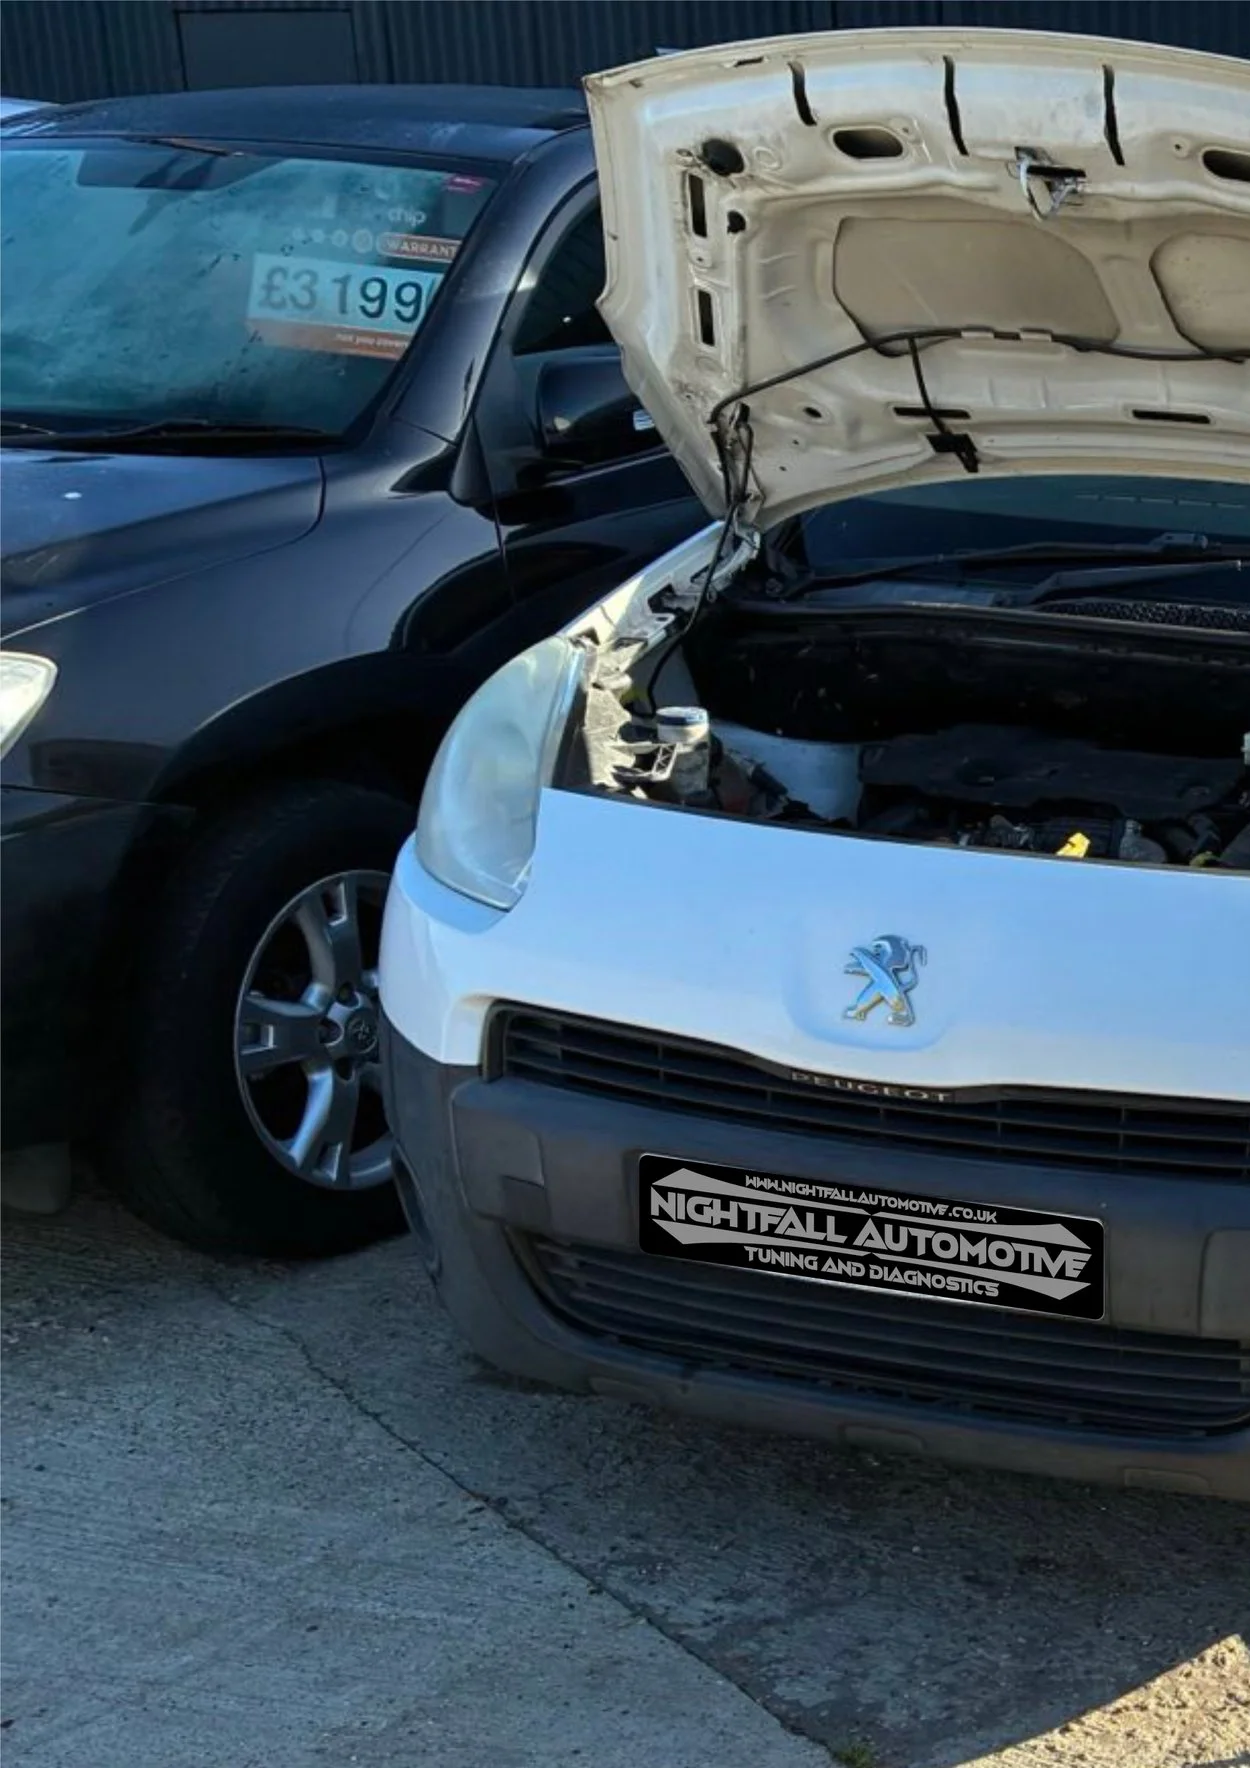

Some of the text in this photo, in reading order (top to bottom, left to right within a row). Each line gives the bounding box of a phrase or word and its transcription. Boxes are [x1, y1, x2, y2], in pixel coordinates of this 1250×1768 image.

[385, 239, 461, 258] WARRANT
[650, 1185, 1093, 1279] NIGHTFALL AUTOMOTIVE
[744, 1245, 1000, 1298] TUNING AND DIAGNOSTICS
